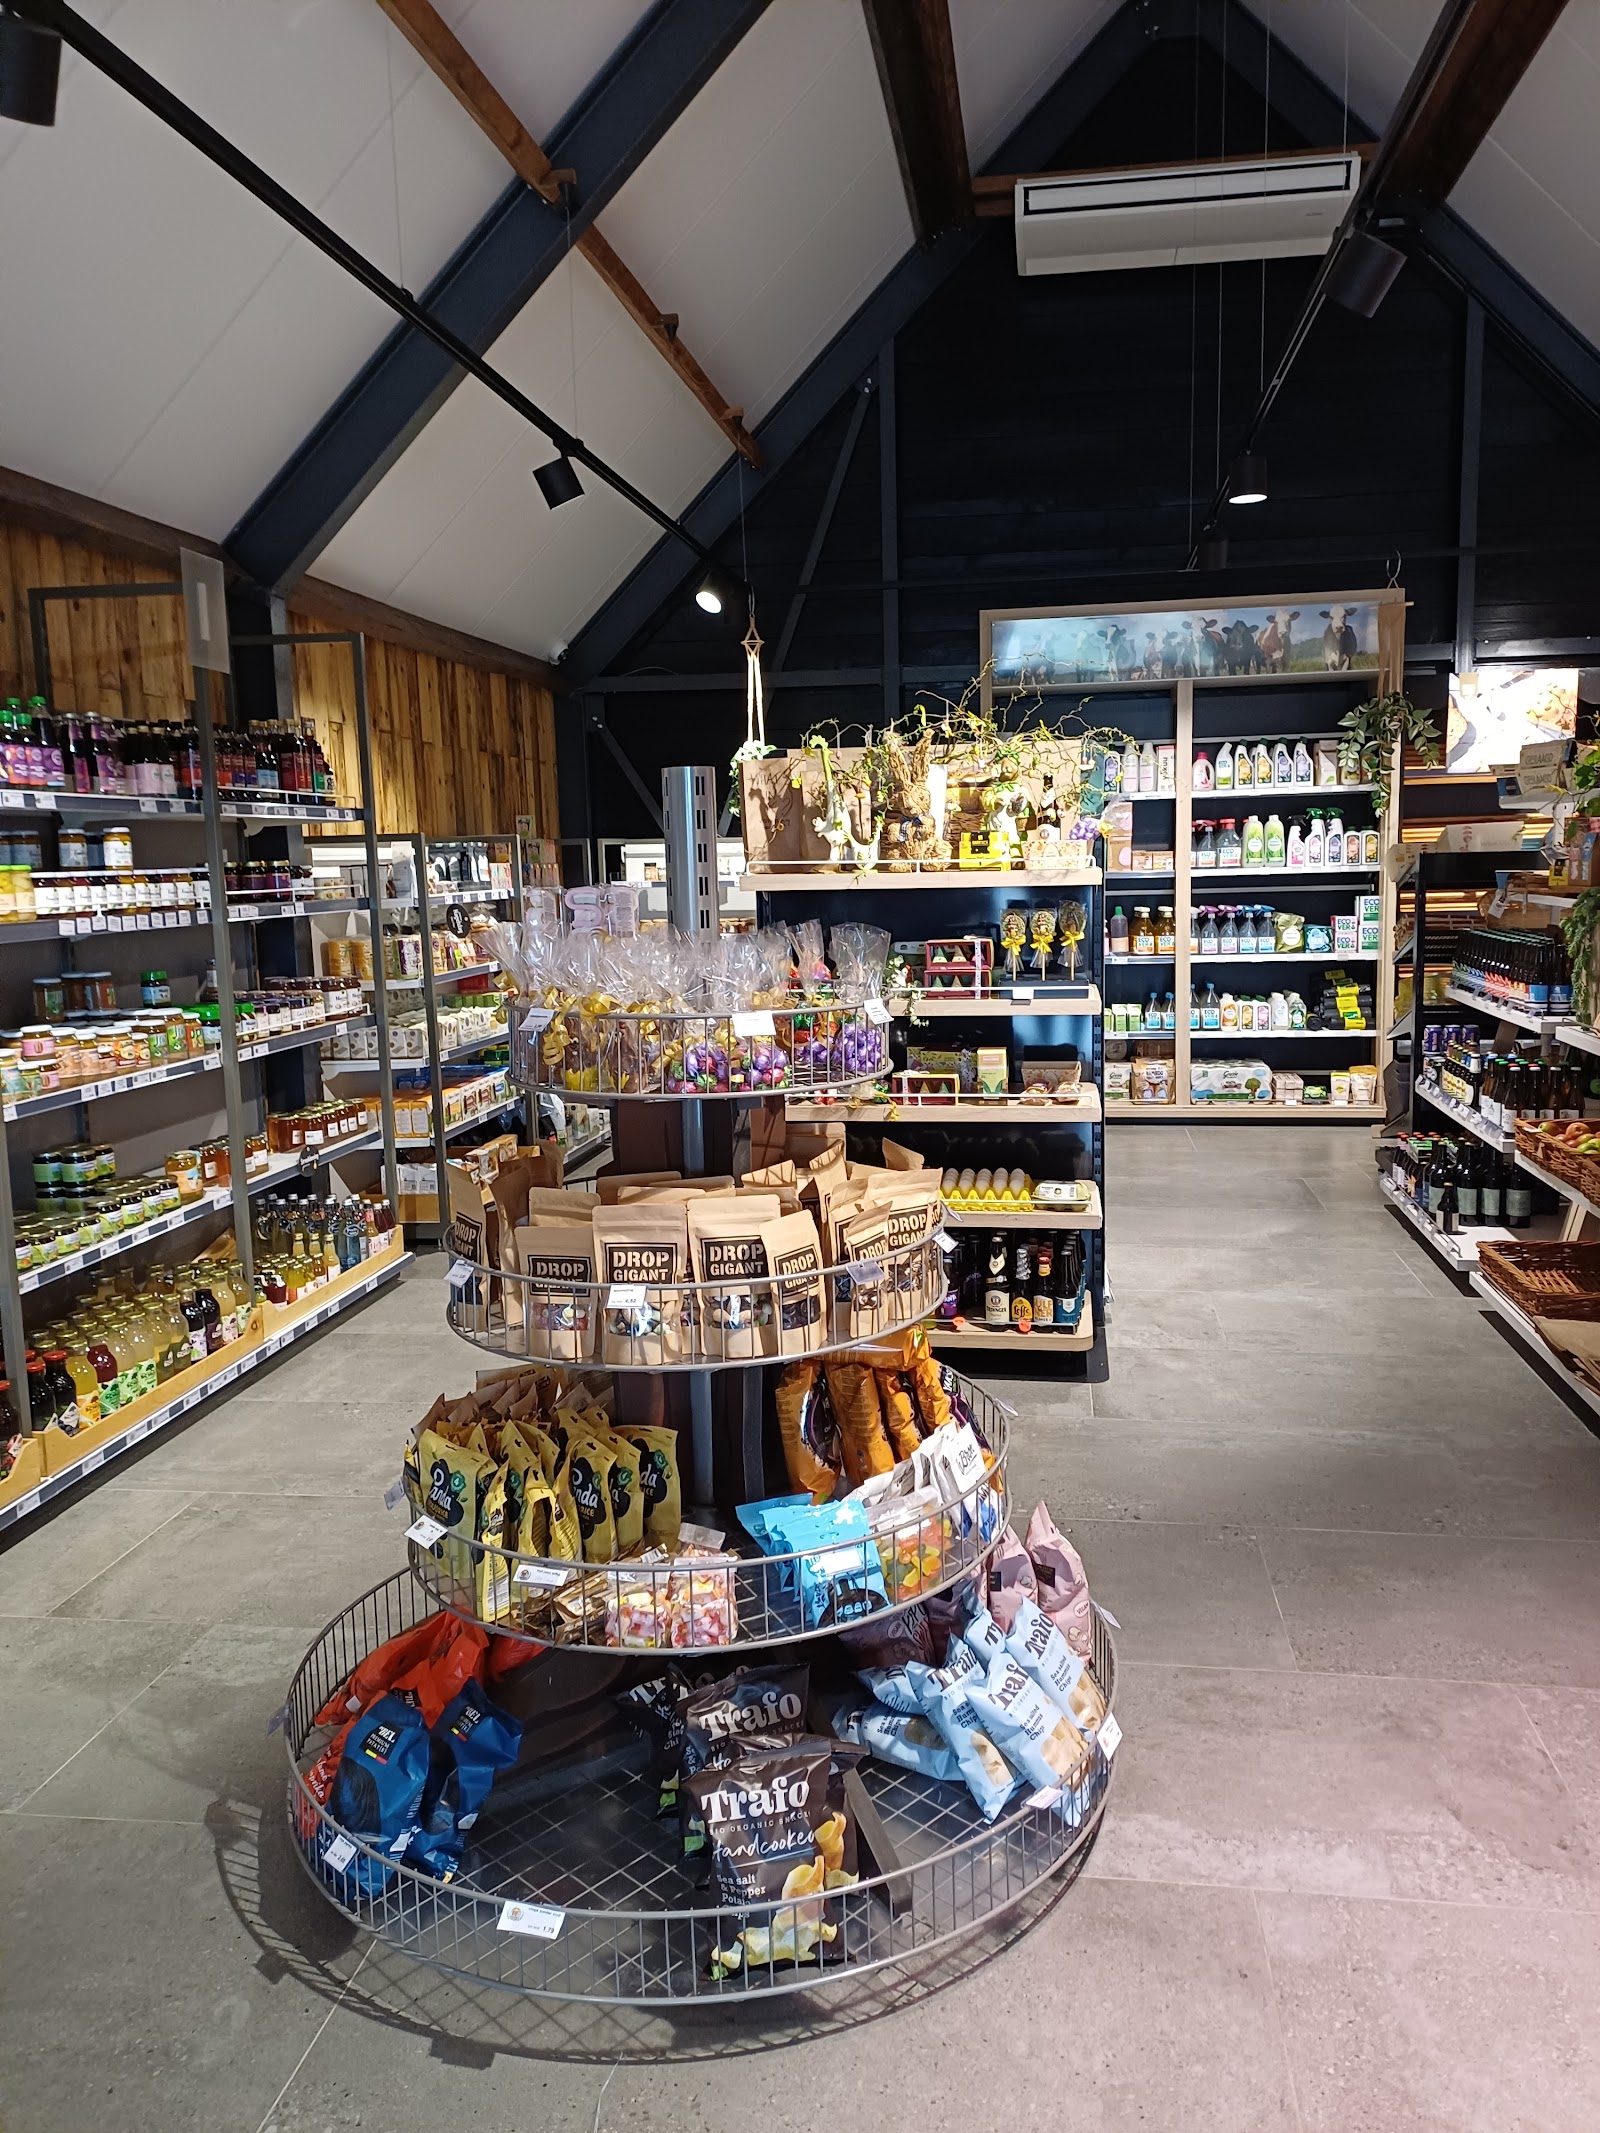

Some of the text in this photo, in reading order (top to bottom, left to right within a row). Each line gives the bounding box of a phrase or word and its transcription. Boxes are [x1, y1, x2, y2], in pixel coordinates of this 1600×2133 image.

[889, 1214, 927, 1234] DROP
[454, 1222, 477, 1243] DROP
[613, 1251, 670, 1268] DROP
[709, 1244, 764, 1262] DROP
[536, 1261, 585, 1277] DROP
[710, 1262, 764, 1276] GIGANT
[782, 1253, 814, 1276] DROP
[613, 1269, 668, 1282] GIGANT
[1014, 1304, 1030, 1317] Leffe
[572, 1468, 598, 1508] Pnda
[988, 1664, 1030, 1711] Traf
[699, 1692, 802, 1742] Trafo
[1020, 1716, 1032, 1731] Sea
[1029, 1725, 1046, 1740] Chips
[700, 1776, 810, 1824] Trafo
[730, 1820, 774, 1833] ORGANIC
[716, 1874, 756, 1886] Sea salt
[720, 1883, 766, 1898] & Pepper
